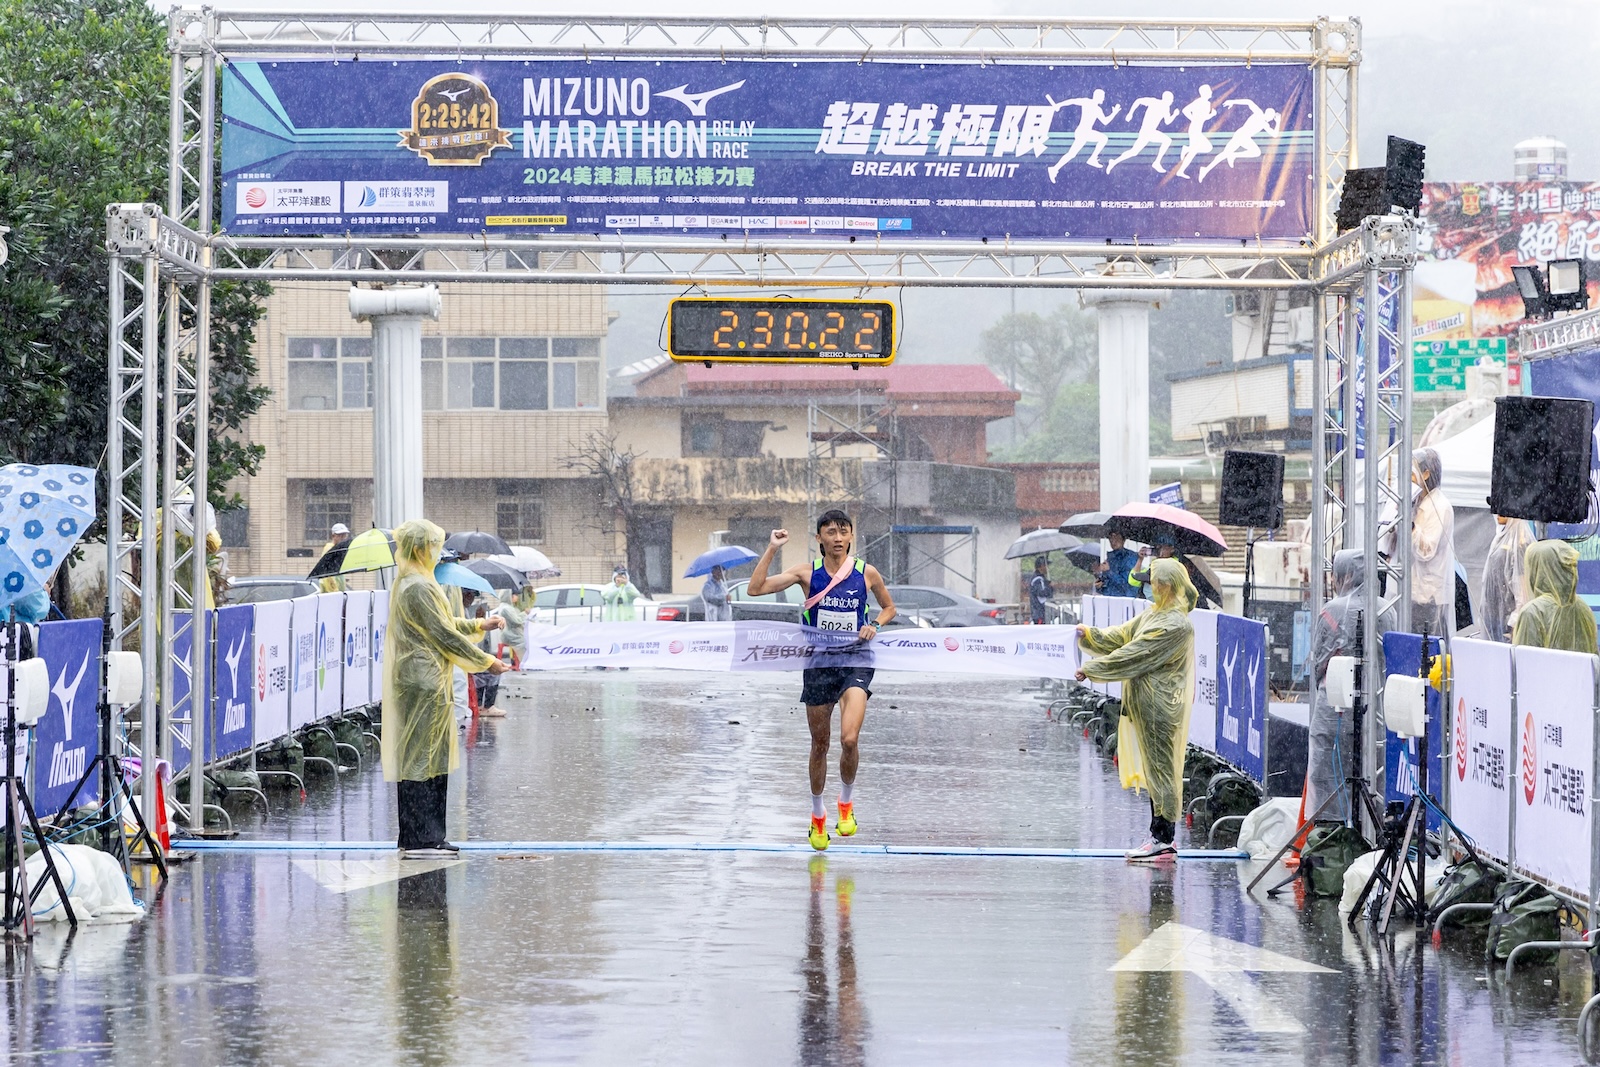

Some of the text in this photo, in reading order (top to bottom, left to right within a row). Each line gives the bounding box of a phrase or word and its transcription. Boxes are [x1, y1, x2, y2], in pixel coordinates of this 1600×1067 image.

[523, 77, 650, 116] MIZUNO
[420, 102, 491, 129] 2:25:42
[523, 120, 707, 158] MARATHON
[713, 120, 755, 137] RELAY
[815, 101, 1055, 158] 超越極限
[712, 142, 749, 159] RACE
[523, 165, 756, 187] 2024美津濃馬拉松接力賽
[851, 161, 1020, 178] BREAK THE LIMIT
[277, 195, 332, 207] 太平洋建設
[378, 186, 435, 198] 群策翡翠灣
[1426, 311, 1462, 332] Miguel
[746, 629, 780, 641] MIZUNO
[820, 620, 853, 631] 502-8
[1472, 739, 1505, 792] 太平洋建設
[1543, 759, 1585, 818] 太平洋建設
